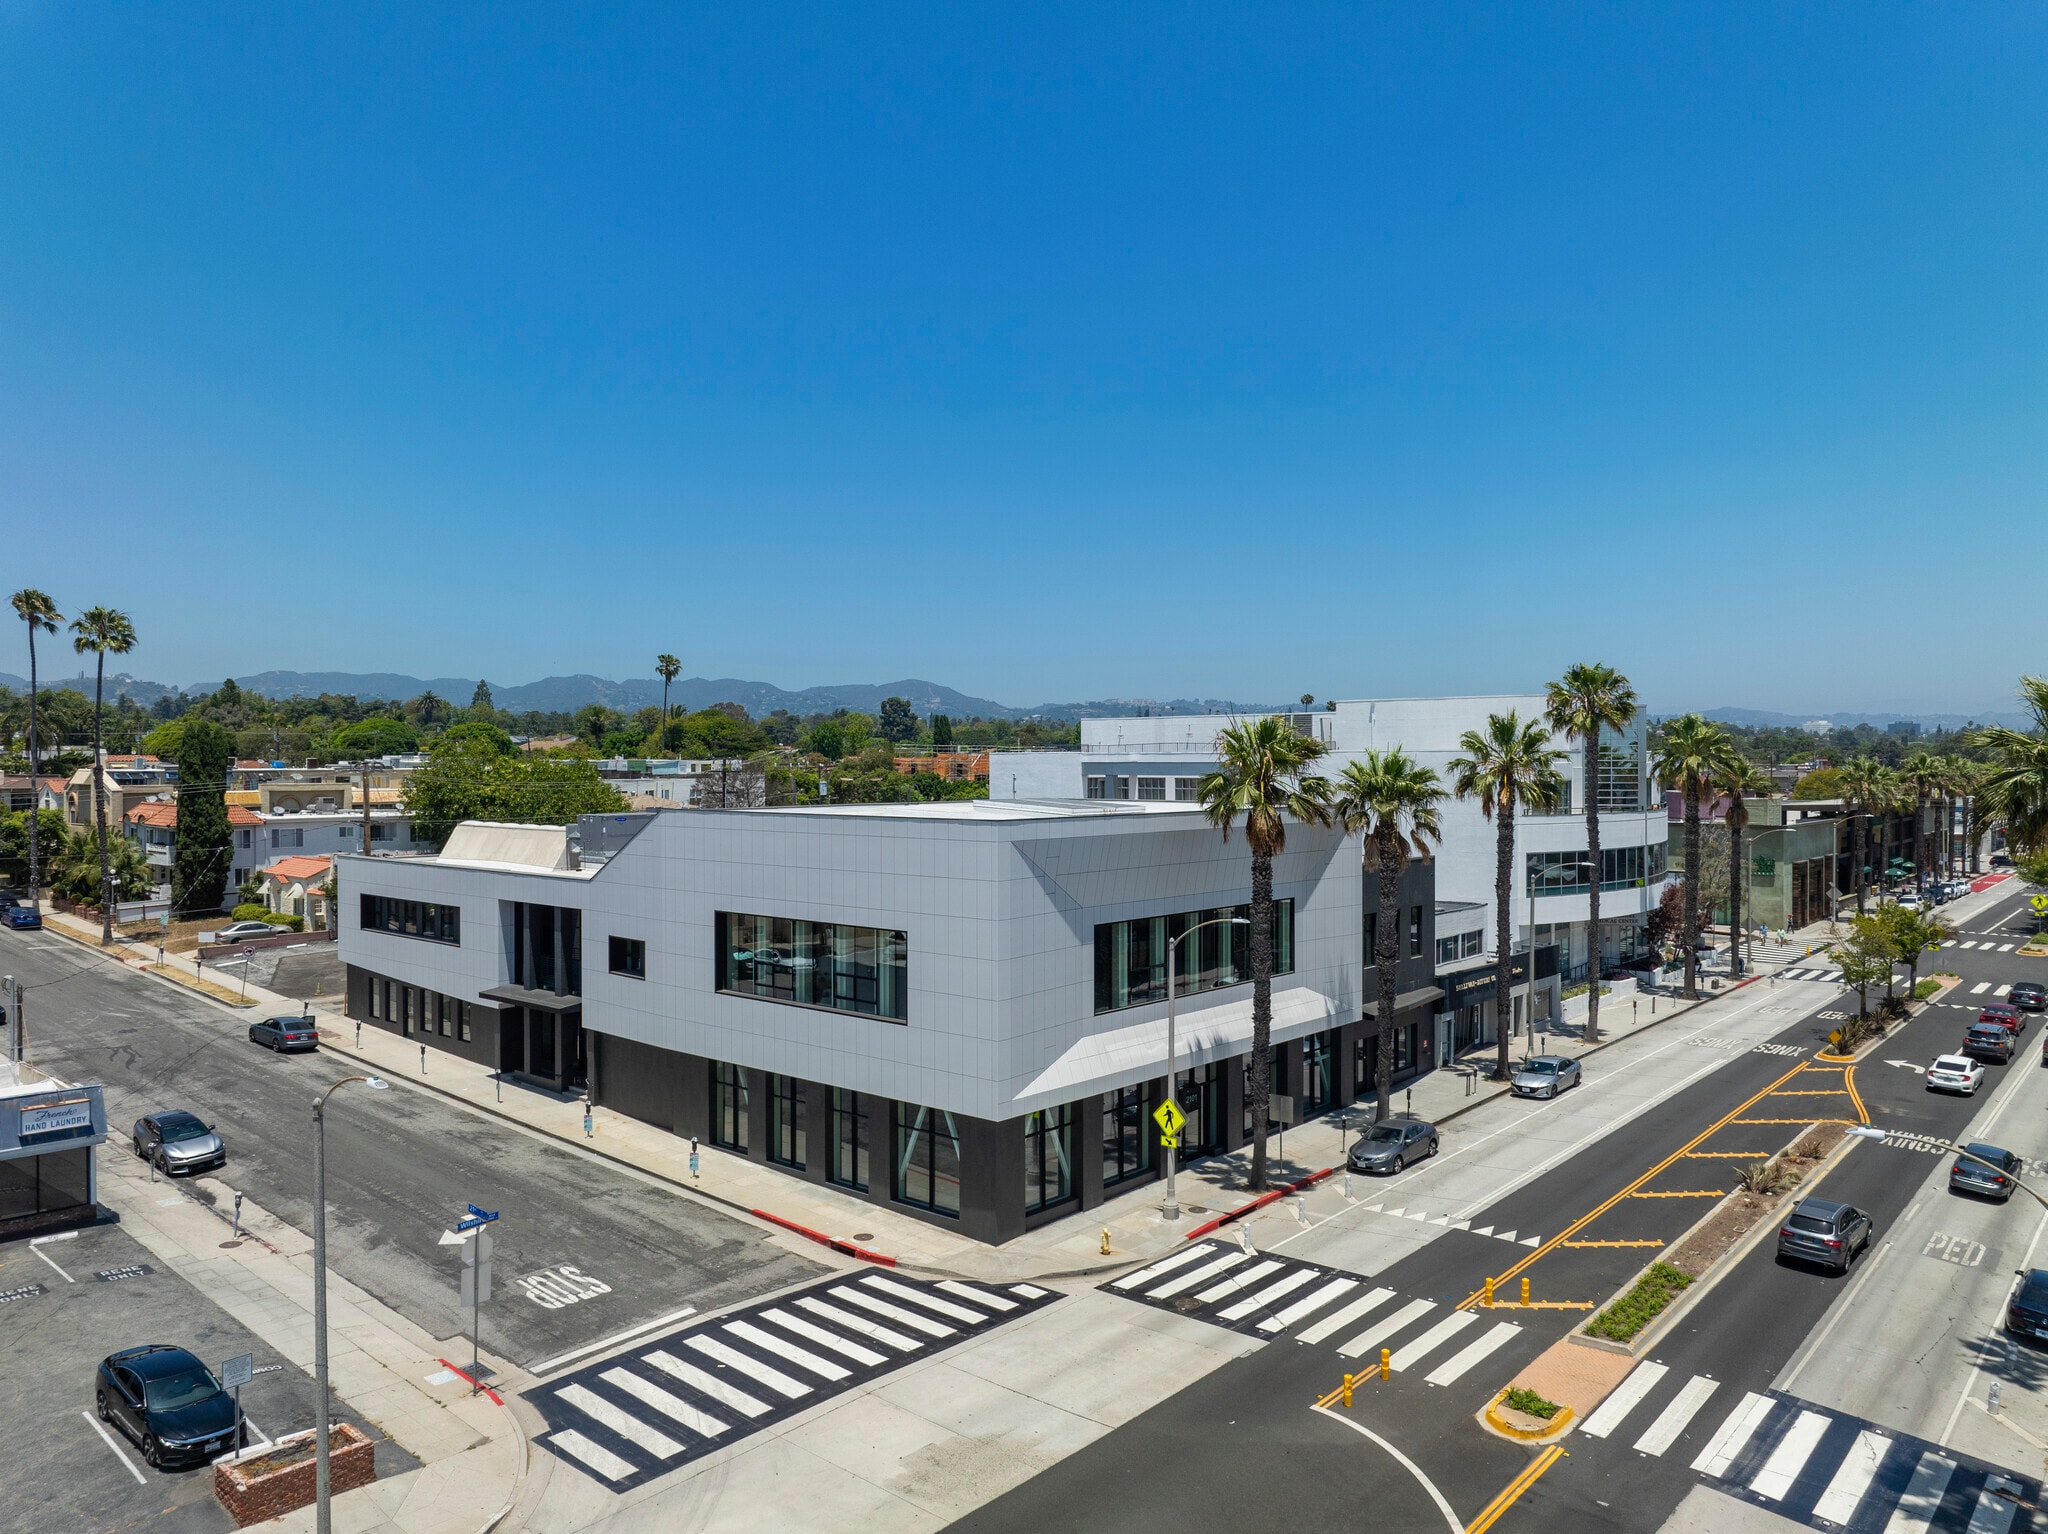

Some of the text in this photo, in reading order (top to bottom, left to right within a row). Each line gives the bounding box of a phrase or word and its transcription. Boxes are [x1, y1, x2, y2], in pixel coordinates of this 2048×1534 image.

[1752, 1043, 1808, 1057] XINGS
[35, 1108, 77, 1122] French
[25, 1116, 87, 1132] HAND LAUNDRY
[1880, 1129, 1952, 1155] XINGS
[1922, 1231, 1987, 1267] PED
[107, 1270, 144, 1281] ONLY
[516, 1266, 612, 1309] STOP
[0, 1290, 40, 1302] ONLY
